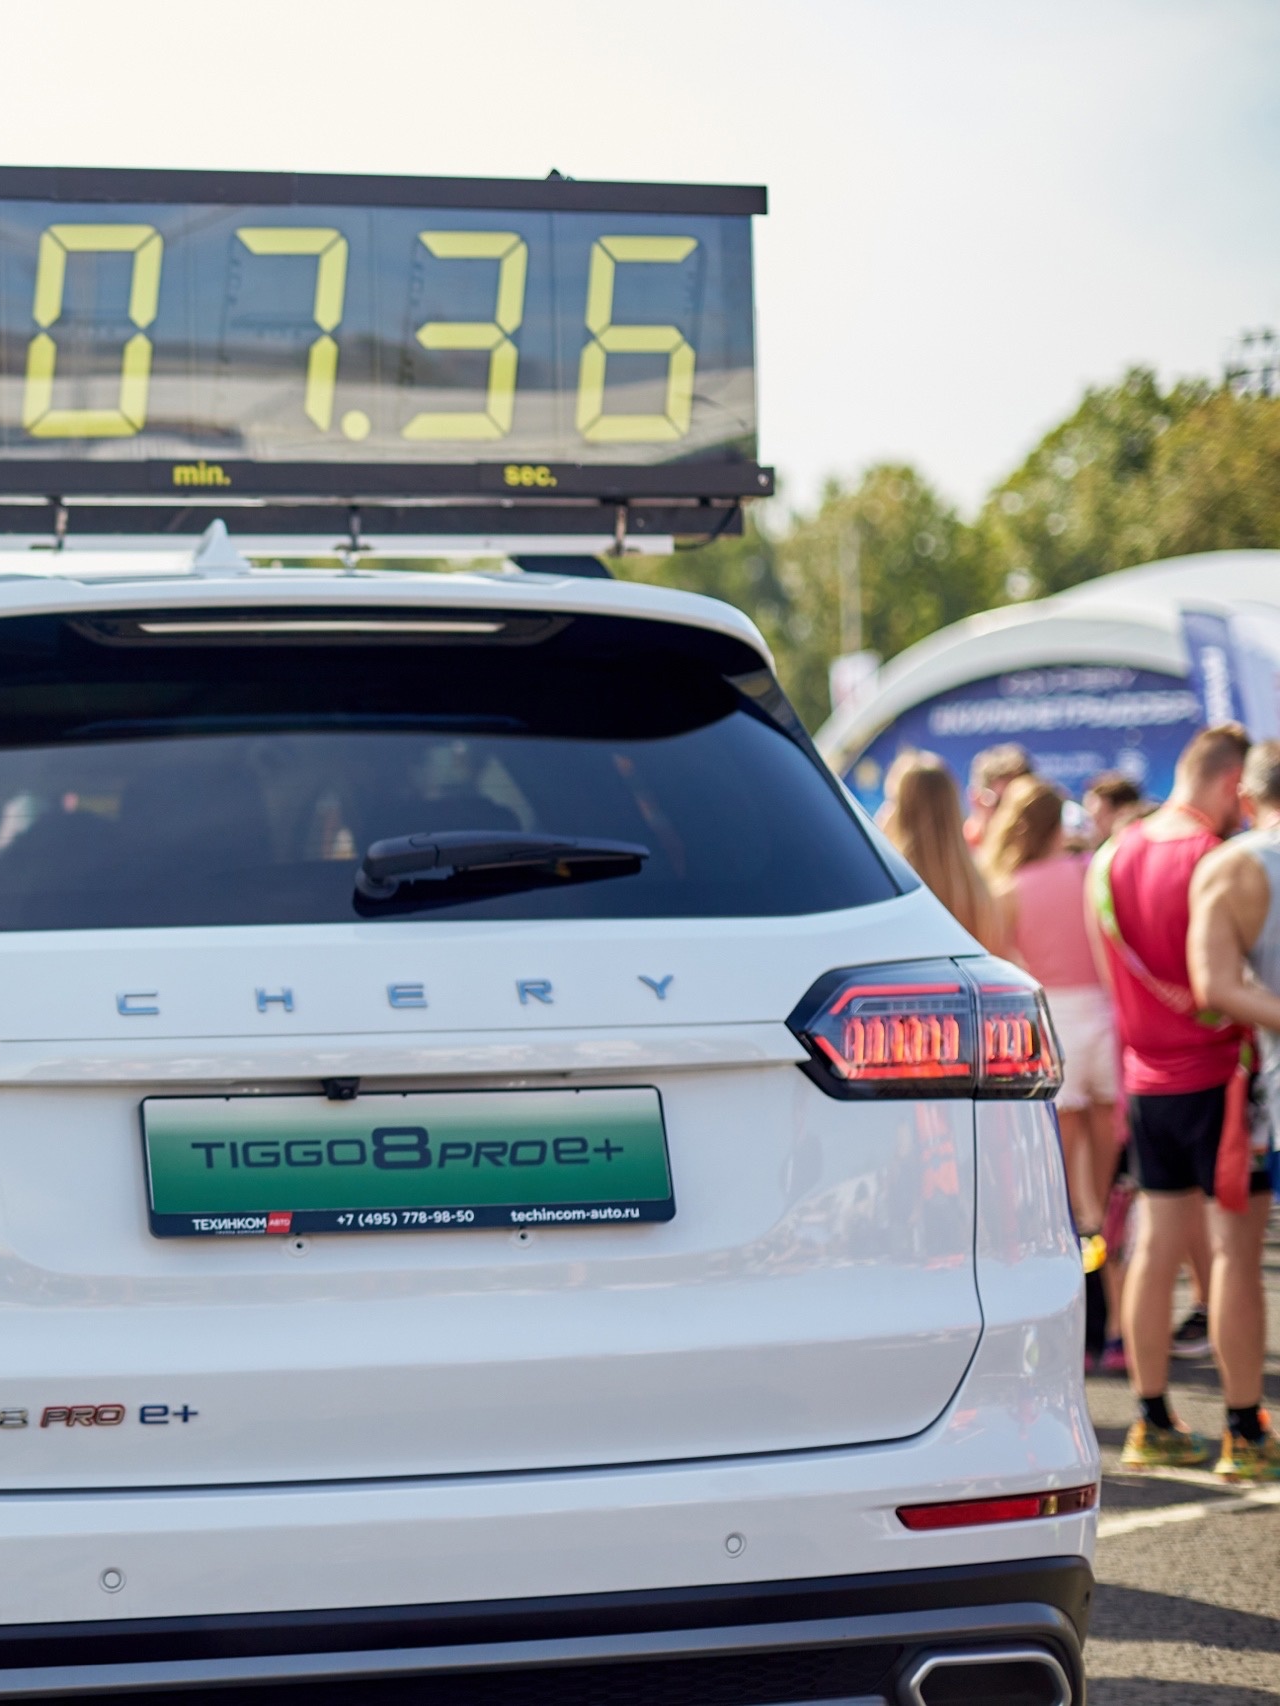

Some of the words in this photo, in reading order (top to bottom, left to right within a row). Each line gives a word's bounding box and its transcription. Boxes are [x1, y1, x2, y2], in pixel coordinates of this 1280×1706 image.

[173, 459, 231, 486] min.
[503, 464, 558, 487] sec.
[117, 974, 674, 1016] CHERY
[192, 1217, 267, 1231] ТЕХИНКОМ
[336, 1213, 354, 1226] +7
[358, 1211, 398, 1227] (495)
[402, 1209, 475, 1225] 778-98-50
[510, 1206, 640, 1223] techincom-auto.ru
[40, 1404, 126, 1428] PRO
[139, 1404, 199, 1425] e+
